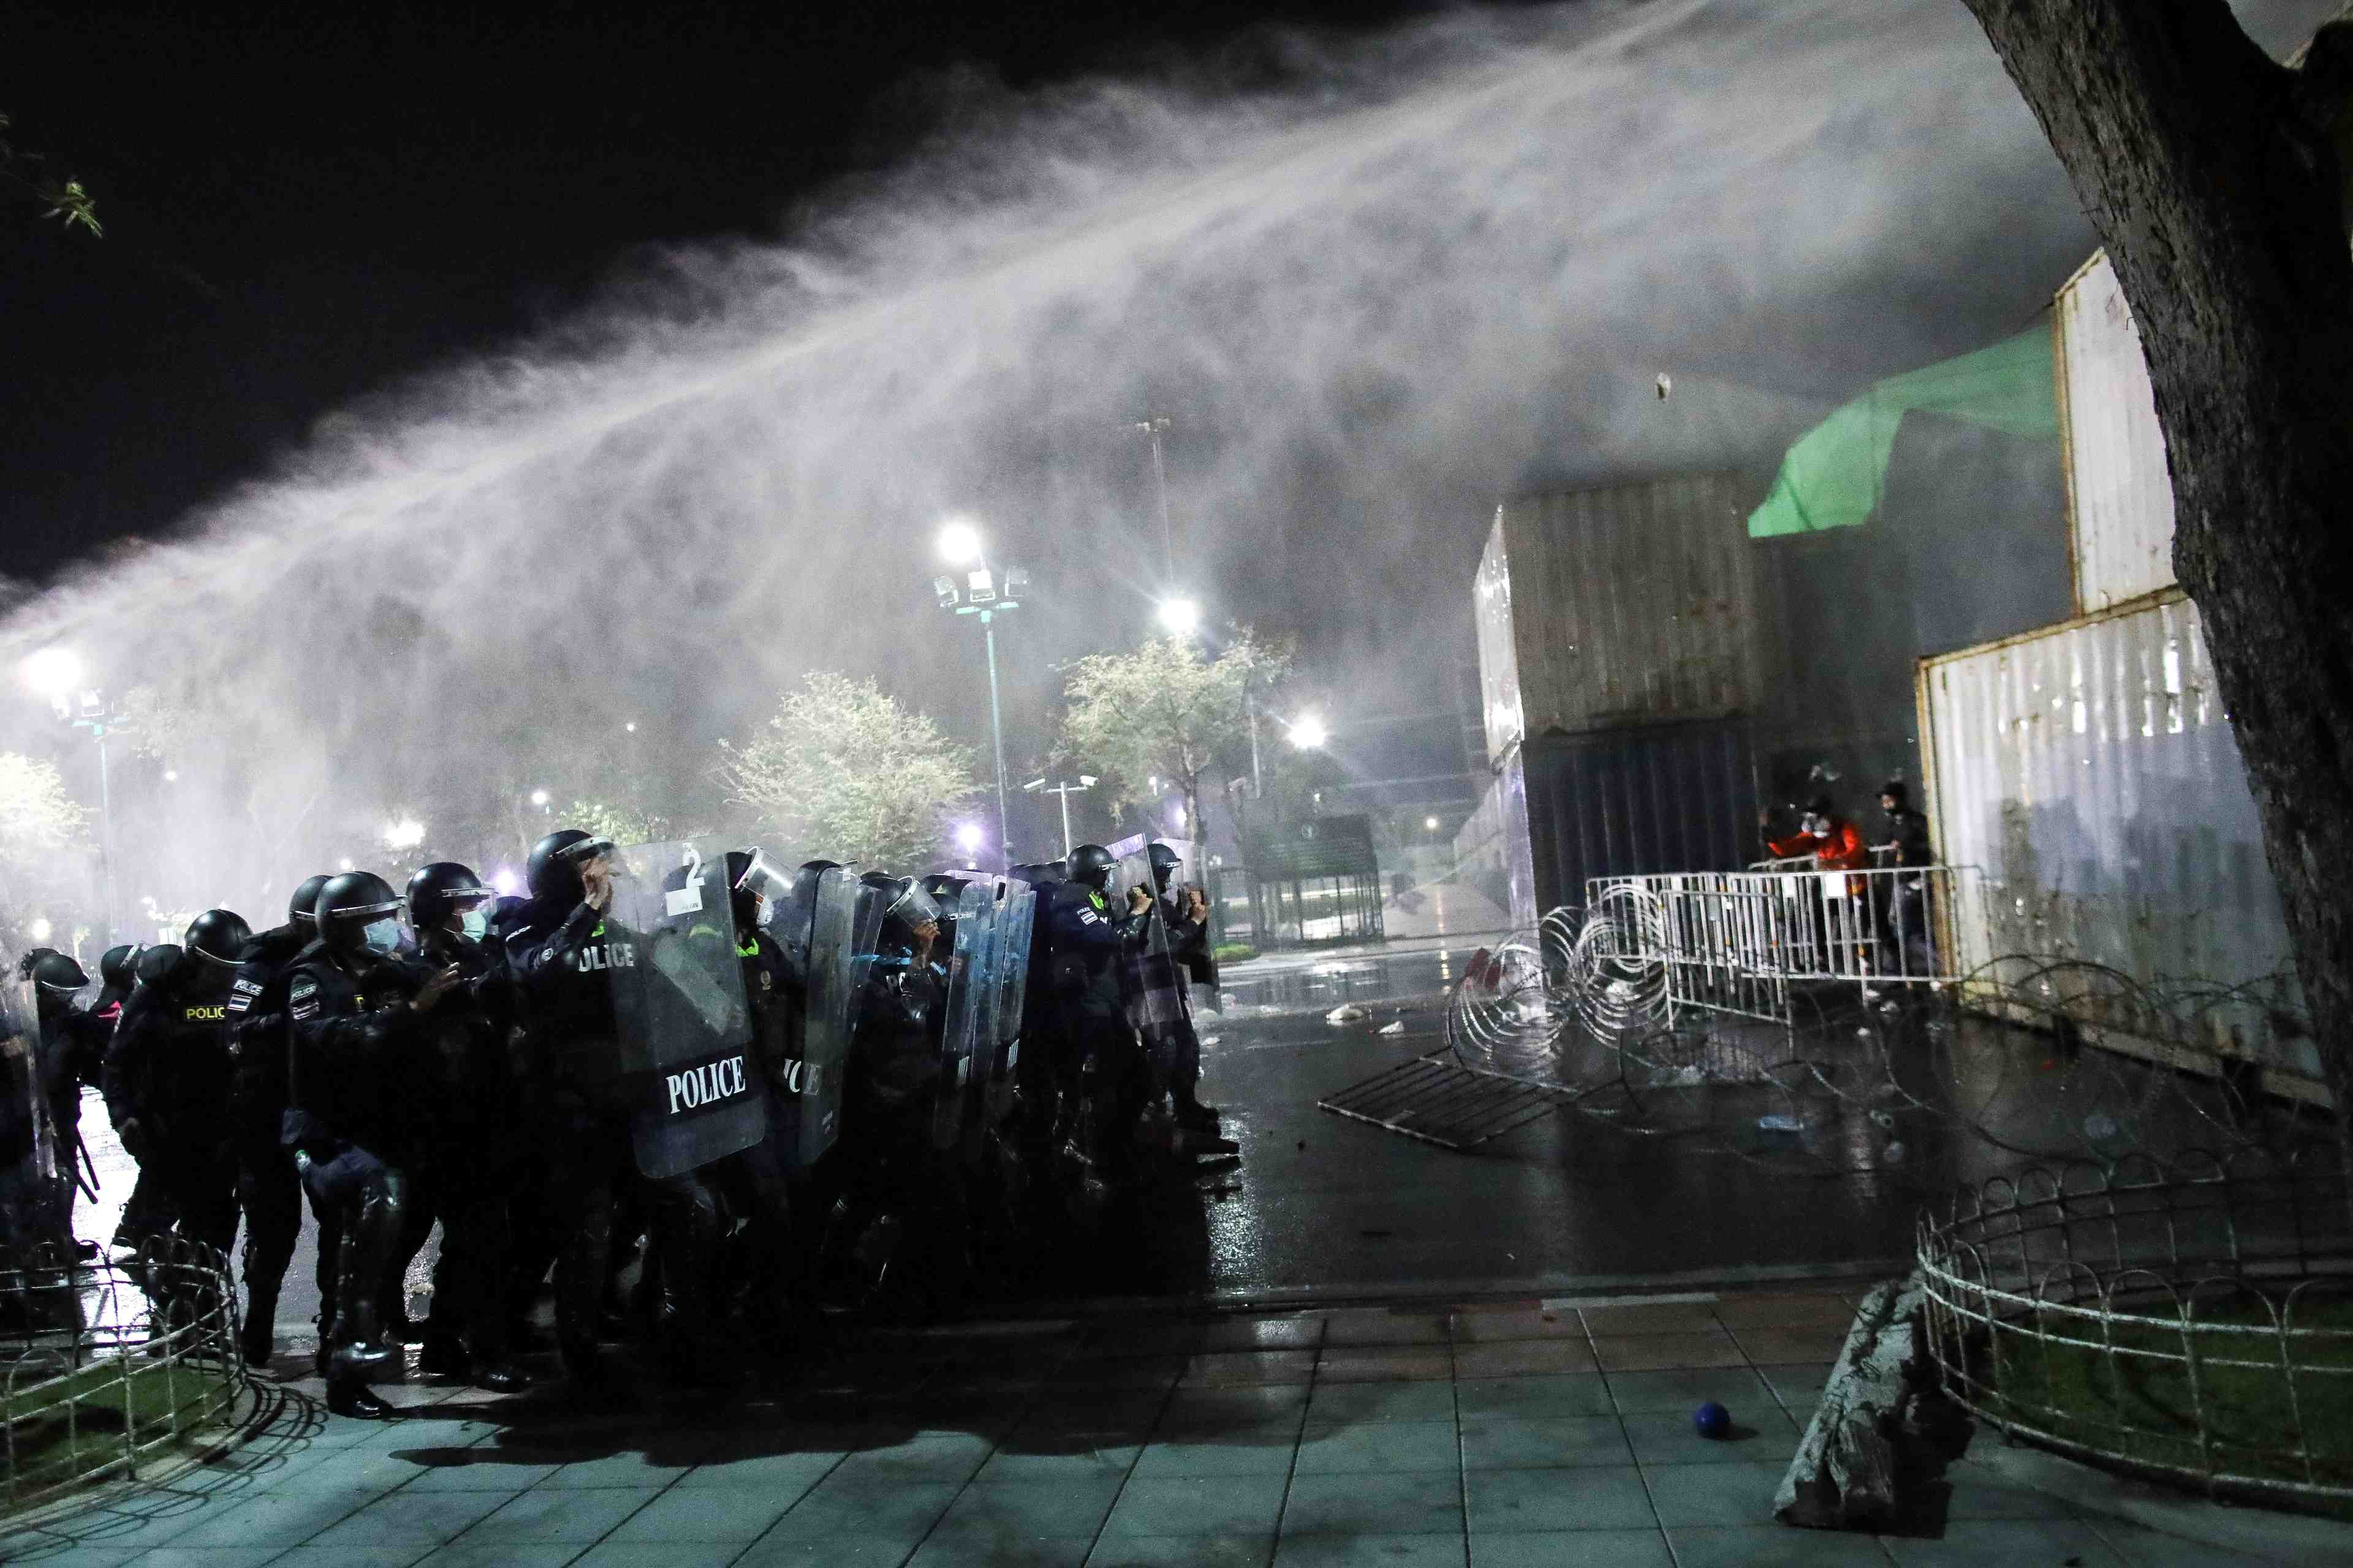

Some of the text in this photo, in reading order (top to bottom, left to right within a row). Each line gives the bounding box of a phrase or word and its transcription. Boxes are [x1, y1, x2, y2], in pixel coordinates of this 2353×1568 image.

[578, 944, 634, 972] OLICE
[234, 980, 263, 995] POLICE
[186, 1007, 225, 1019] POLIC
[666, 1056, 746, 1114] POLICE
